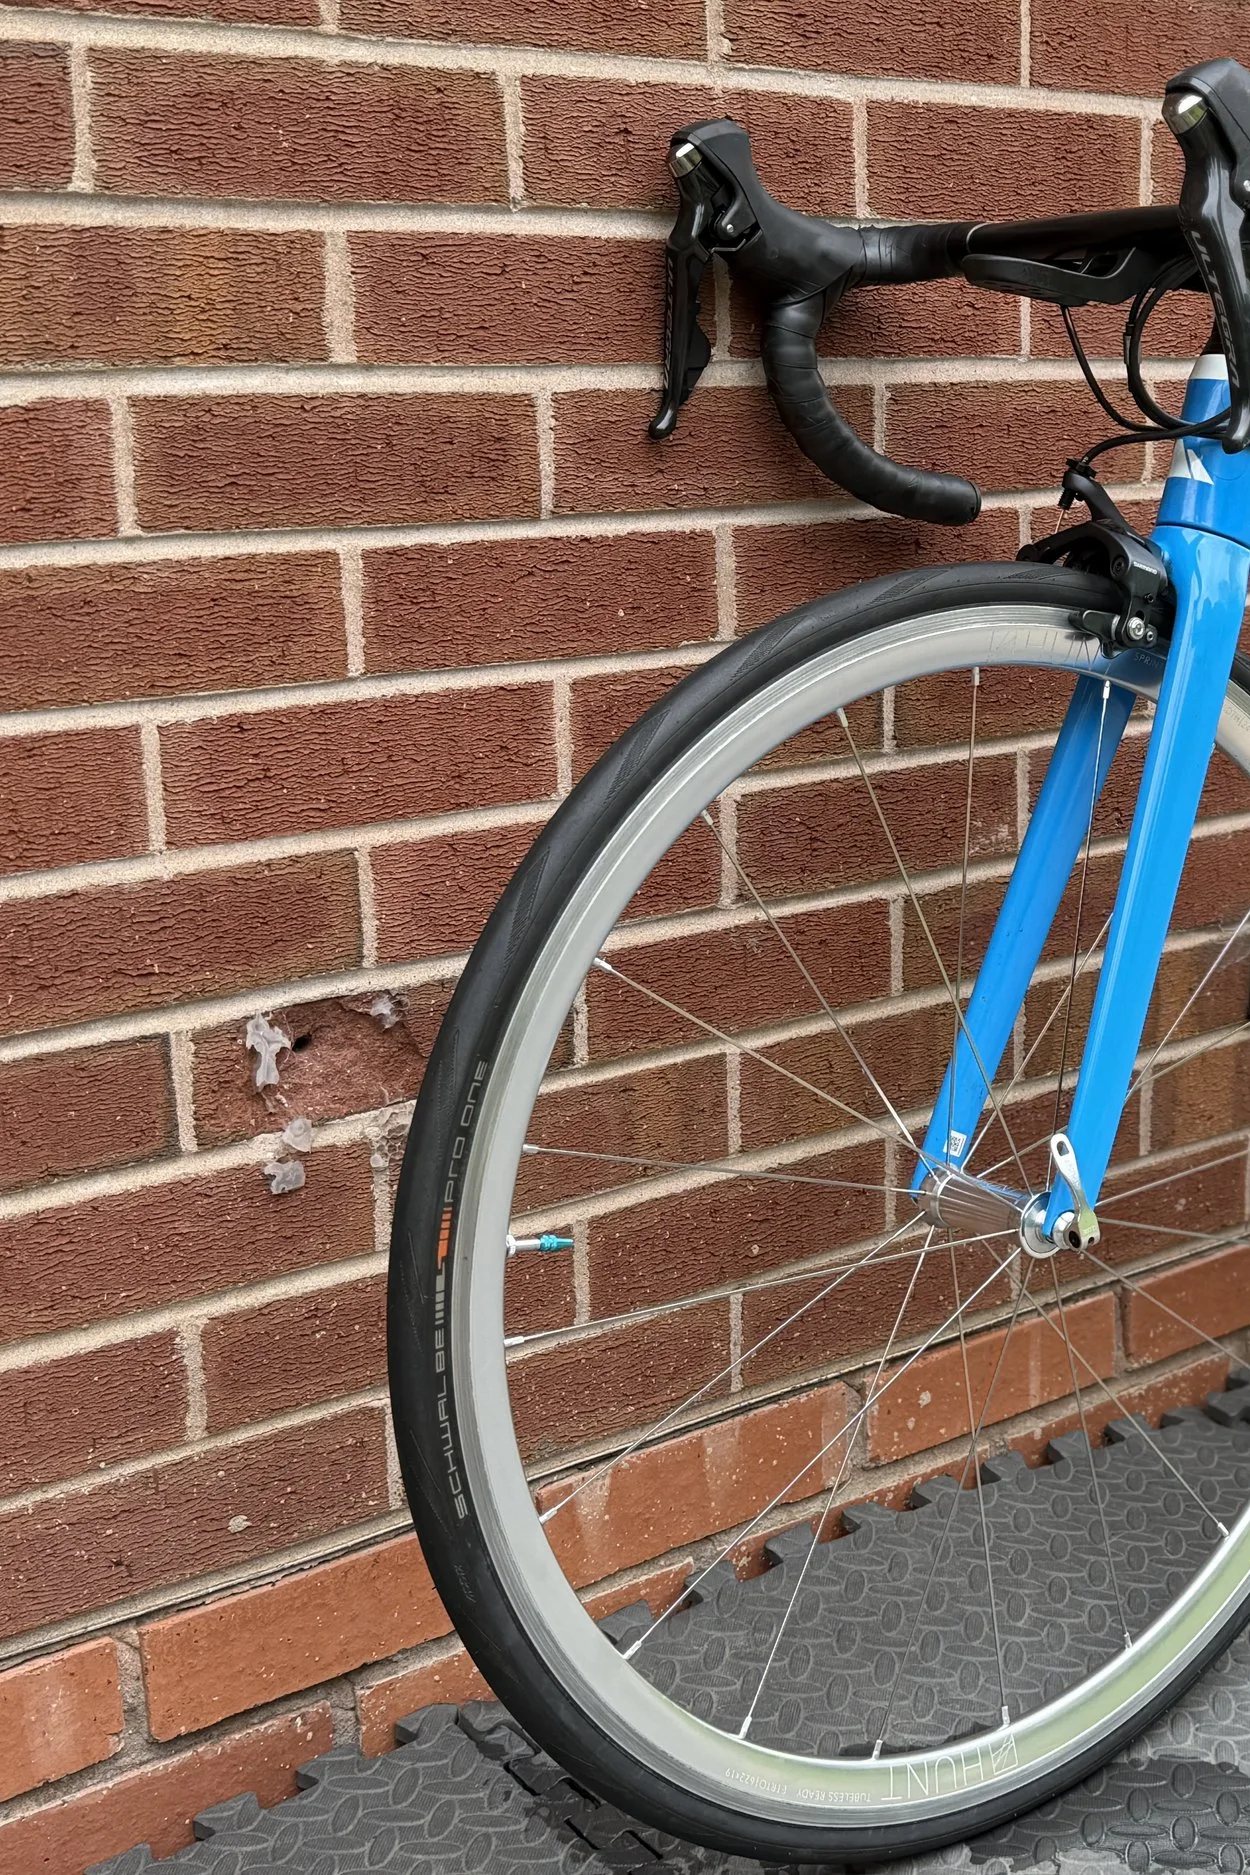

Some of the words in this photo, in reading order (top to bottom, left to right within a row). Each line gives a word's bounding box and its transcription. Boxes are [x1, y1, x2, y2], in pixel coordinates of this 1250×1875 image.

[1191, 230, 1240, 389] ULTEGRA
[434, 1327, 470, 1520] SCHWALBE
[796, 1788, 825, 1801] READY
[828, 1791, 872, 1803] TUBELESS
[880, 1746, 983, 1800] HUNT
